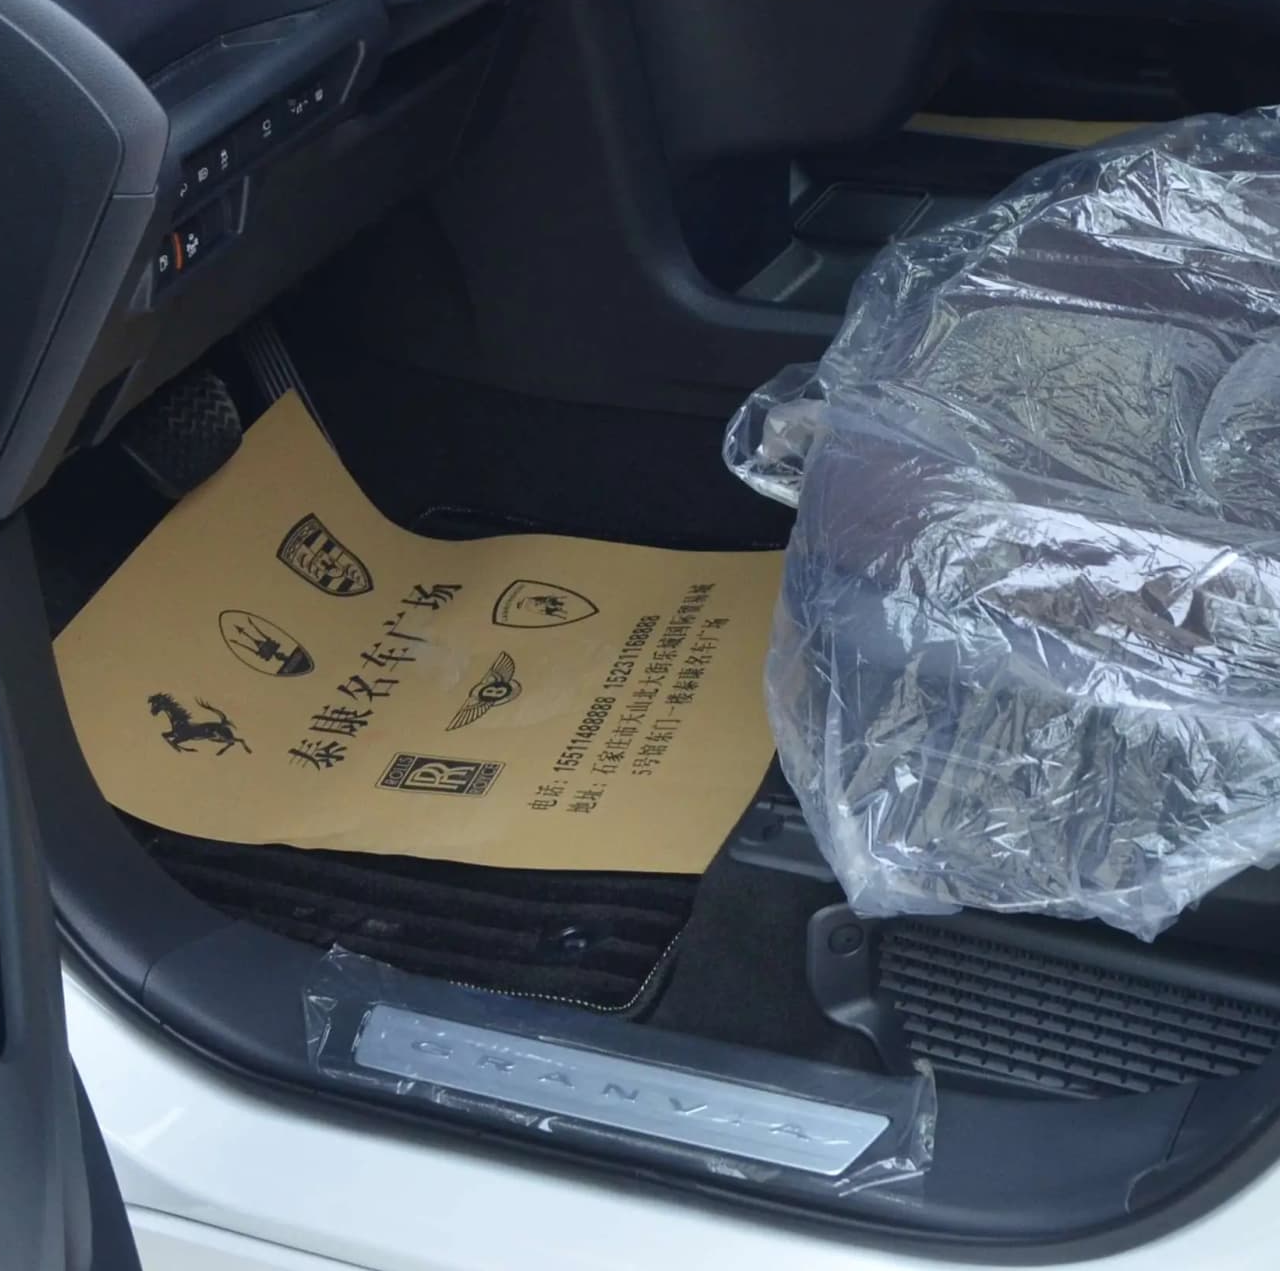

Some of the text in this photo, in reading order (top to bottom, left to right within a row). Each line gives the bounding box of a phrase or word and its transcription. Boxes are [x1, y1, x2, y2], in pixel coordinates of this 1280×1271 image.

[287, 580, 463, 774] 泰康名车广场
[410, 1039, 812, 1141] GRANVIA
